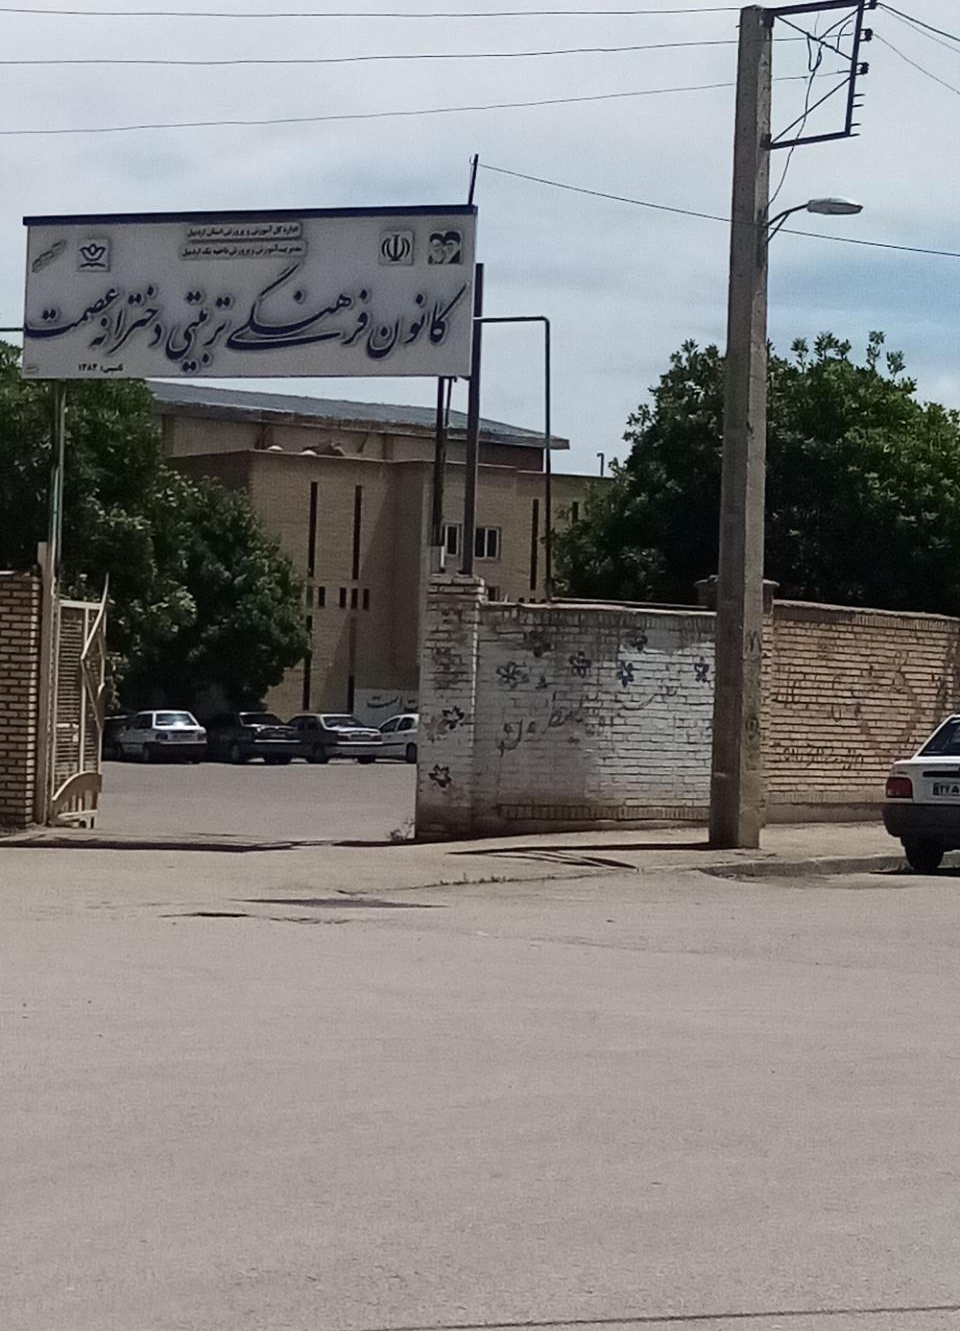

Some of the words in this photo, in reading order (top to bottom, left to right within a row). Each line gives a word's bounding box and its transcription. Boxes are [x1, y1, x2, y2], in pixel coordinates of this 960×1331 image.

[23, 287, 120, 338] عصمت
[87, 285, 162, 354] دخترانه
[165, 290, 230, 372] تربیتی
[226, 262, 368, 350] فرهنگی
[367, 283, 468, 359] کانون
